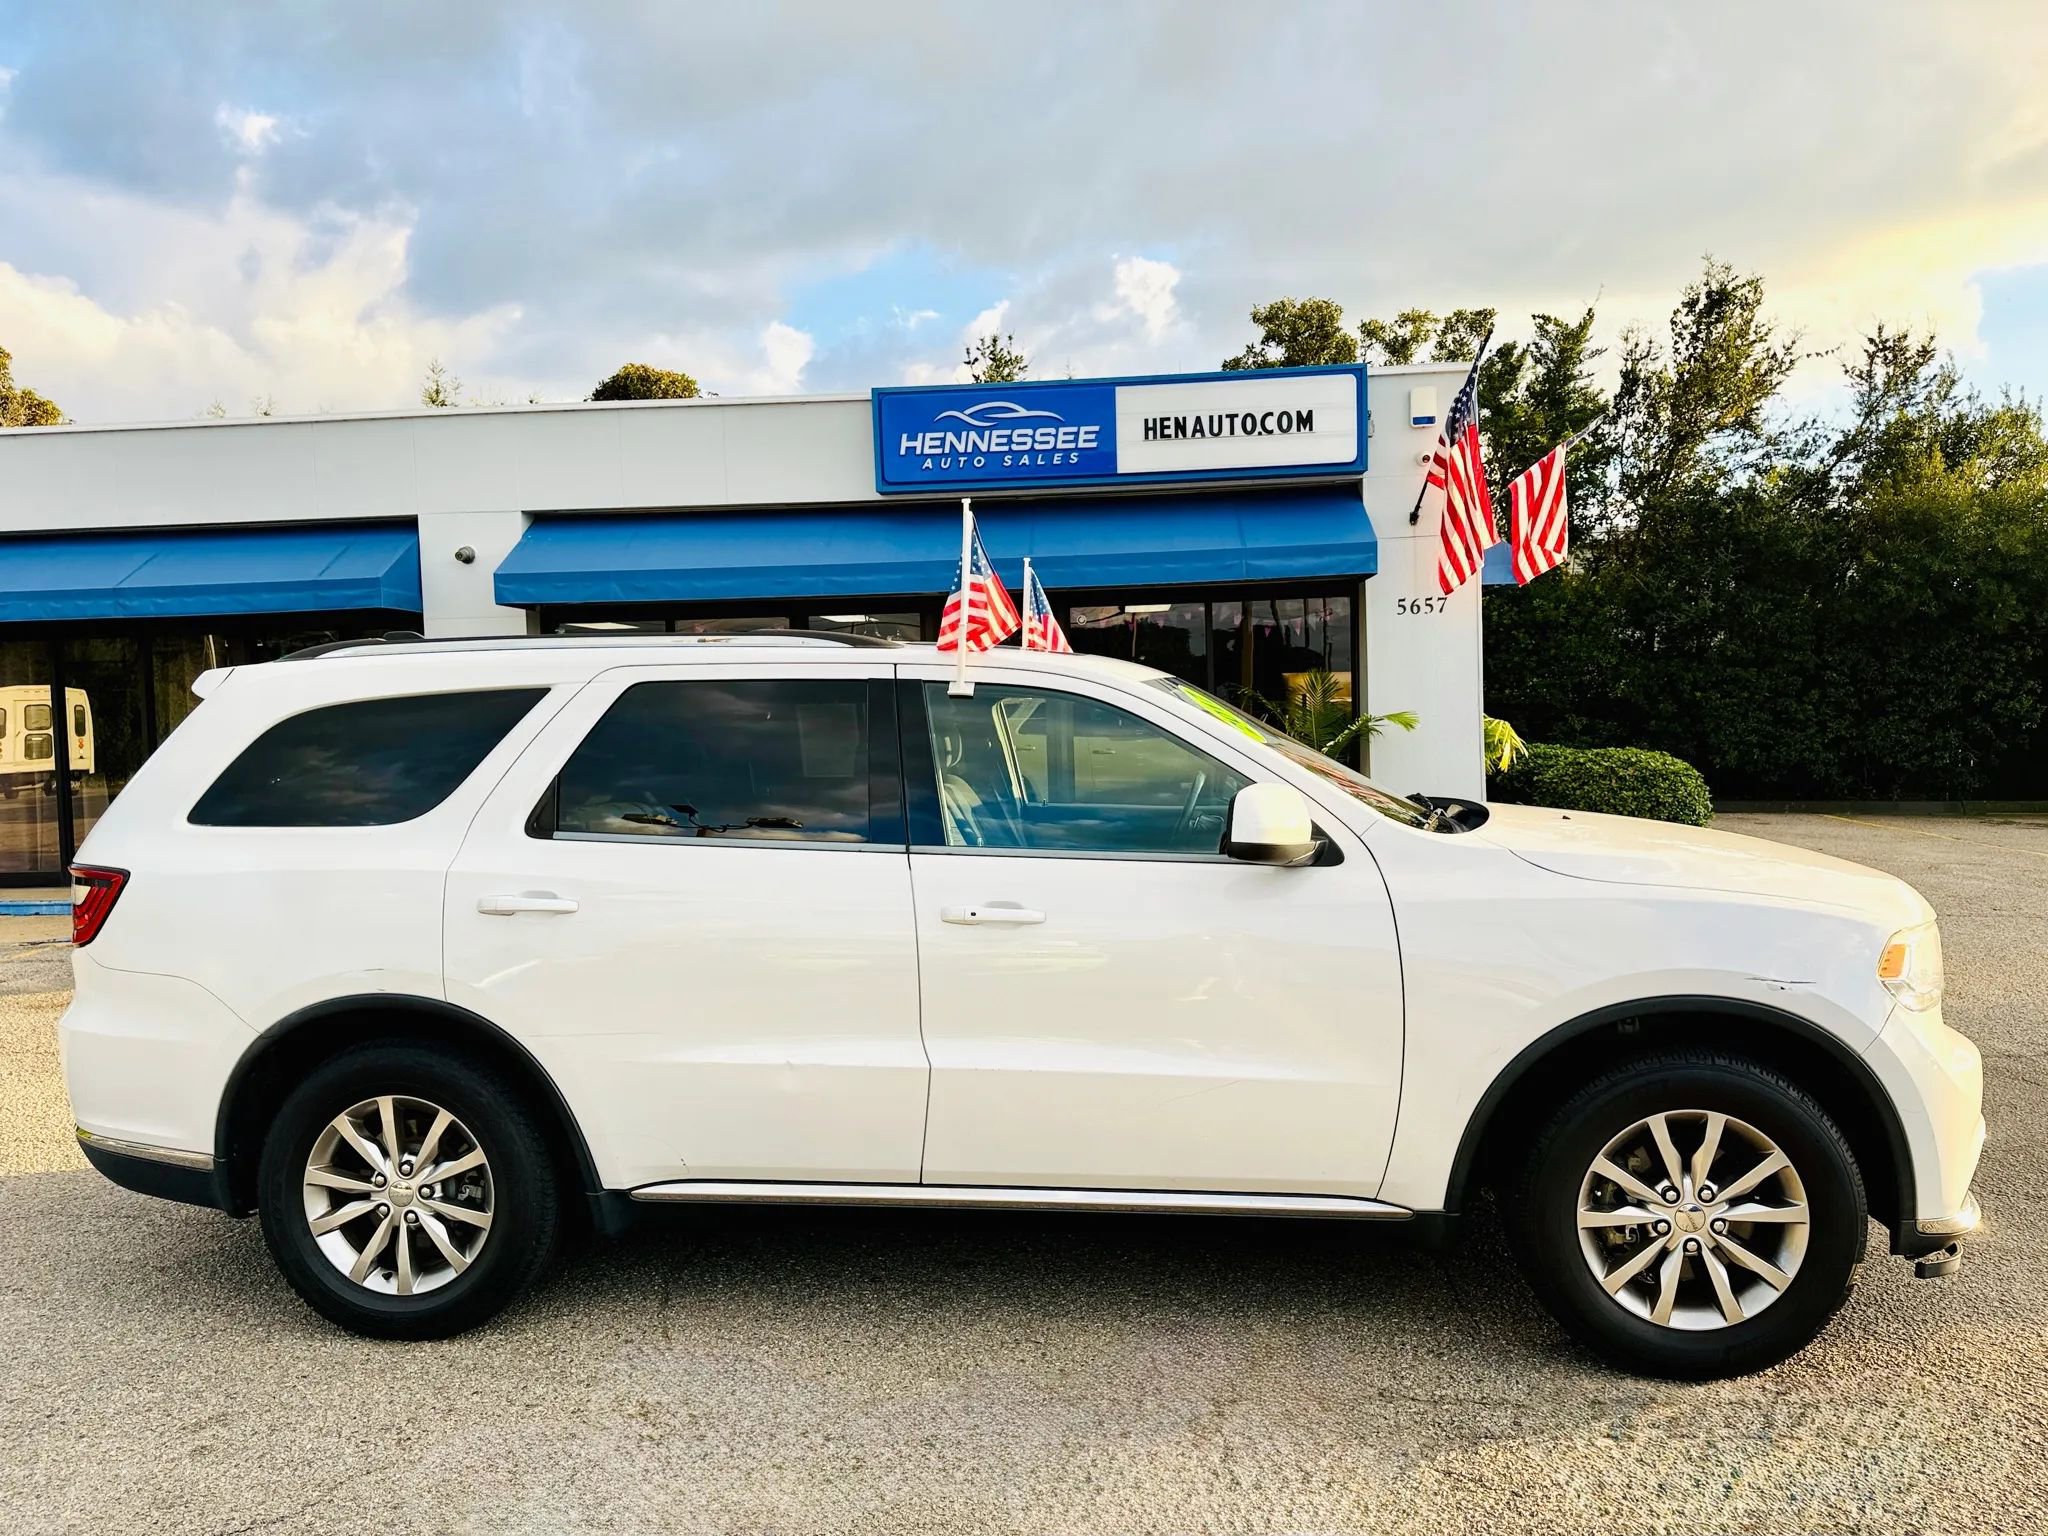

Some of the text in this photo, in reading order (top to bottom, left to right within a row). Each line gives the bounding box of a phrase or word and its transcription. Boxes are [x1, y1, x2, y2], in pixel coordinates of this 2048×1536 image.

[1143, 409, 1314, 441] HENAUTO.COM
[899, 425, 1100, 456] HENNESSEE
[922, 452, 1080, 470] AUTO SALES
[1396, 596, 1448, 616] 5657
